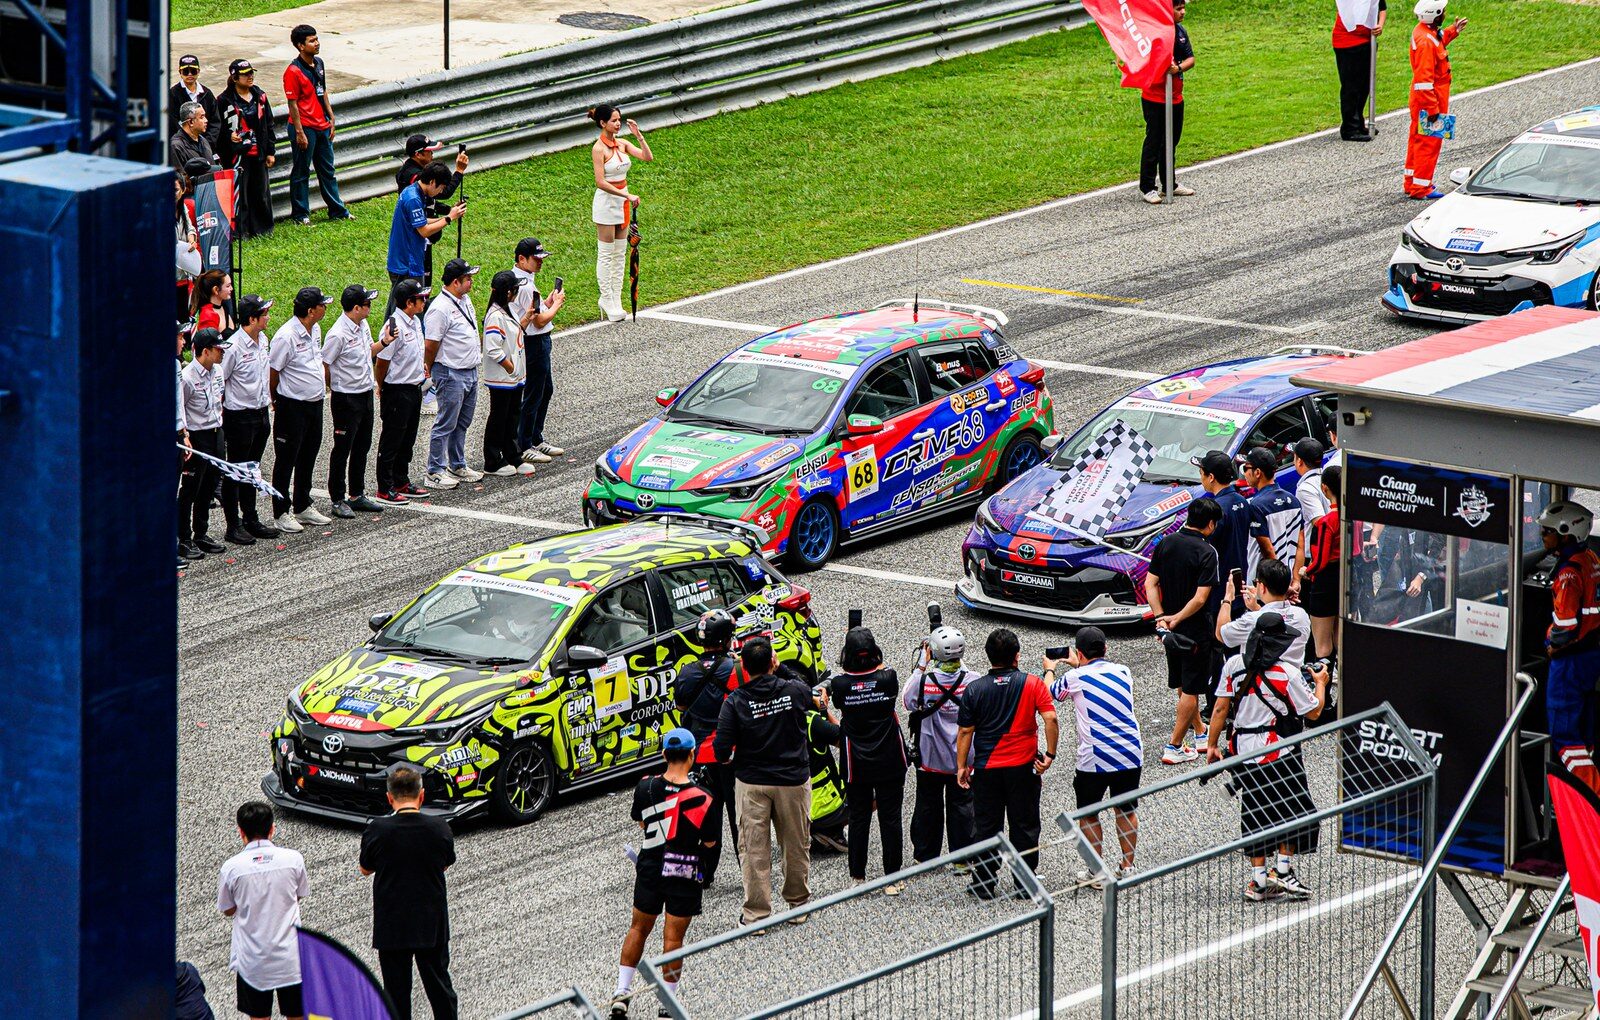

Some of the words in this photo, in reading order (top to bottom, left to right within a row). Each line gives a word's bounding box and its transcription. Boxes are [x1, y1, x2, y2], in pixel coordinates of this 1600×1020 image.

[1441, 283, 1476, 295] YOKOHAMA
[752, 356, 783, 364] TOYOTA
[783, 359, 814, 368] GAZOO
[811, 377, 843, 395] 68
[1141, 403, 1172, 412] TOYOTA
[1174, 406, 1206, 416] GAZOO
[1206, 412, 1236, 423] Racing
[1205, 422, 1237, 437] 53
[795, 452, 829, 482] LENSO
[853, 462, 874, 489] 68
[1379, 474, 1417, 494] Chang
[1158, 492, 1192, 512] Trane
[1360, 486, 1435, 507] INTERNATIONAL
[1378, 499, 1418, 514] CIRCUIT
[472, 578, 505, 588] TOYOTA
[506, 582, 540, 595] GAZOO
[540, 588, 572, 601] Racing
[1013, 573, 1053, 588] YOKOHAMA
[550, 603, 567, 621] 7
[345, 673, 421, 698] DPA
[605, 676, 617, 702] 7
[635, 666, 678, 704] DP
[325, 687, 418, 710] CORPORATION
[567, 695, 593, 717] EMP
[845, 693, 861, 701] Making
[631, 699, 677, 721] CORPORA
[325, 714, 364, 730] MOTUL
[1359, 739, 1443, 767] PODIM
[319, 768, 356, 784] YOKOHAMA
[457, 773, 478, 782] MOTUL
